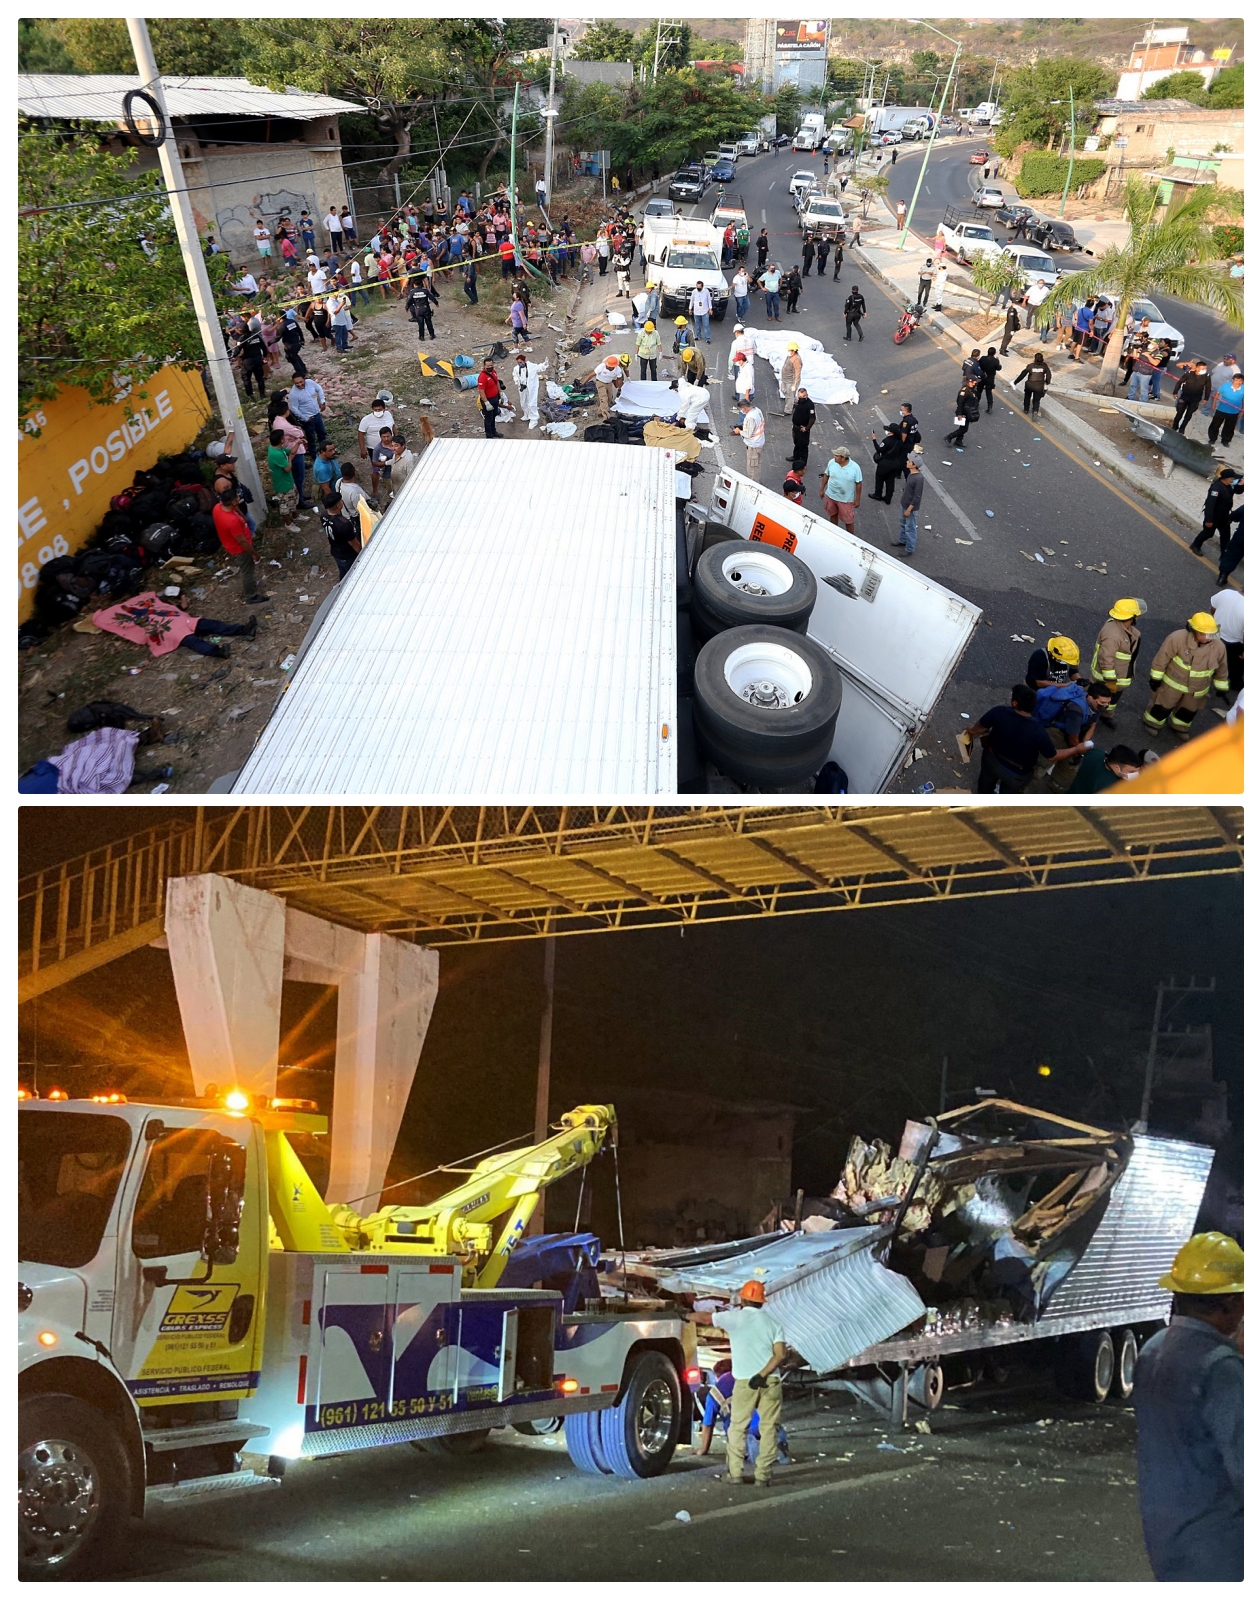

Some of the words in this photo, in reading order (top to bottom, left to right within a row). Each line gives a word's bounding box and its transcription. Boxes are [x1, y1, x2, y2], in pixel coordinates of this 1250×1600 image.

[68, 389, 174, 495] POSIBLE
[163, 1313, 227, 1325] GREXSS
[141, 1367, 172, 1376] SERVICIO
[202, 1364, 231, 1372] FEDERAL
[133, 1386, 170, 1395] ASISTENCIA
[180, 1383, 210, 1392] TRASLADO
[219, 1380, 250, 1389] REMOLQUE
[321, 1402, 358, 1428] (961)
[362, 1401, 385, 1420] 121
[390, 1399, 406, 1417] 55
[410, 1397, 425, 1414] 50
[439, 1394, 453, 1411] 51
